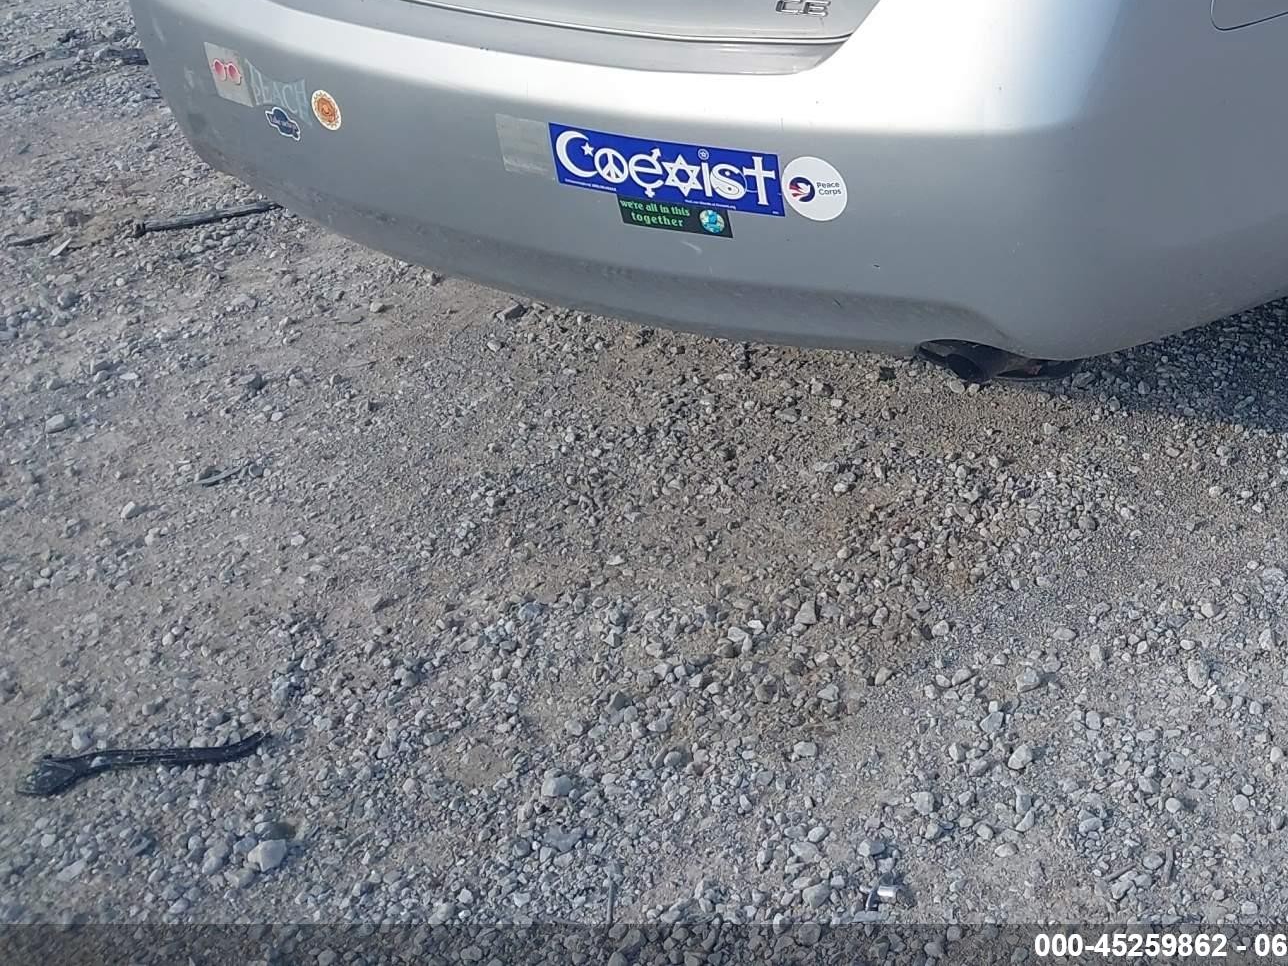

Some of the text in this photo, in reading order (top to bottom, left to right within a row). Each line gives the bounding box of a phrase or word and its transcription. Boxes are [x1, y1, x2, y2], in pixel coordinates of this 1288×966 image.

[619, 200, 690, 216] we're all in this
[631, 212, 684, 227] together
